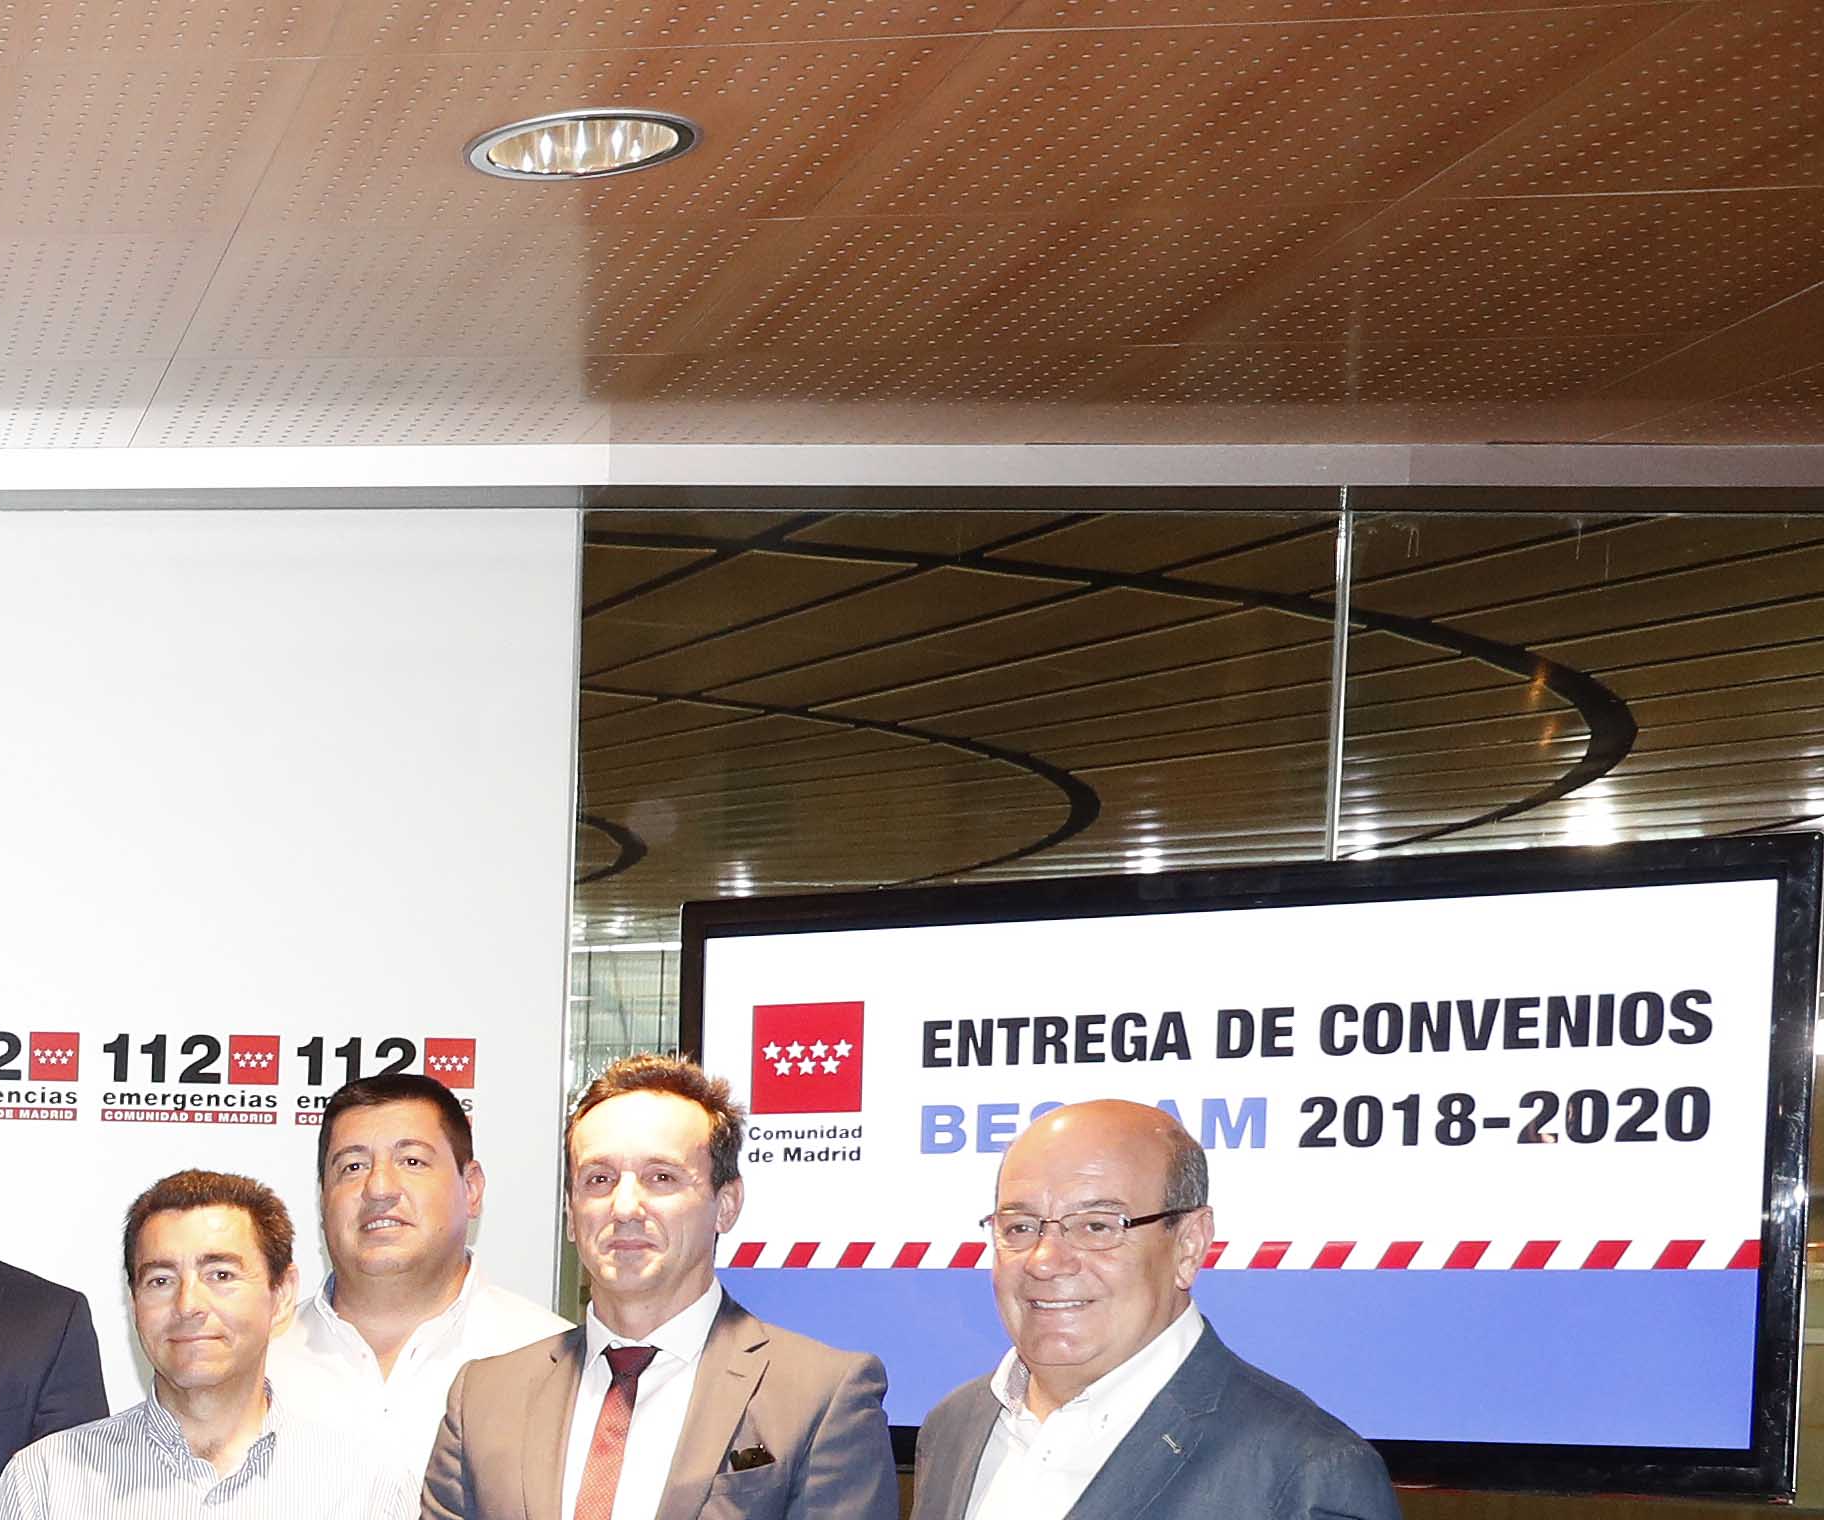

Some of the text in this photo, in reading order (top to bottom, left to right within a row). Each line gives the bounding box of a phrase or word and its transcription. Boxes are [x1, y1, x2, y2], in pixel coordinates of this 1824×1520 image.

[921, 988, 1714, 1069] ENTREGA DE CONVENIOS
[103, 1033, 222, 1084] 112
[296, 1036, 417, 1086] 112
[102, 1089, 278, 1111] emergencias
[19, 1109, 74, 1120] MADRID
[104, 1111, 274, 1124] COMUNIDAD DE MADRID
[1298, 1085, 1713, 1150] 2018-2020
[747, 1125, 863, 1142] Comunidad
[747, 1146, 862, 1164] de Madrid
